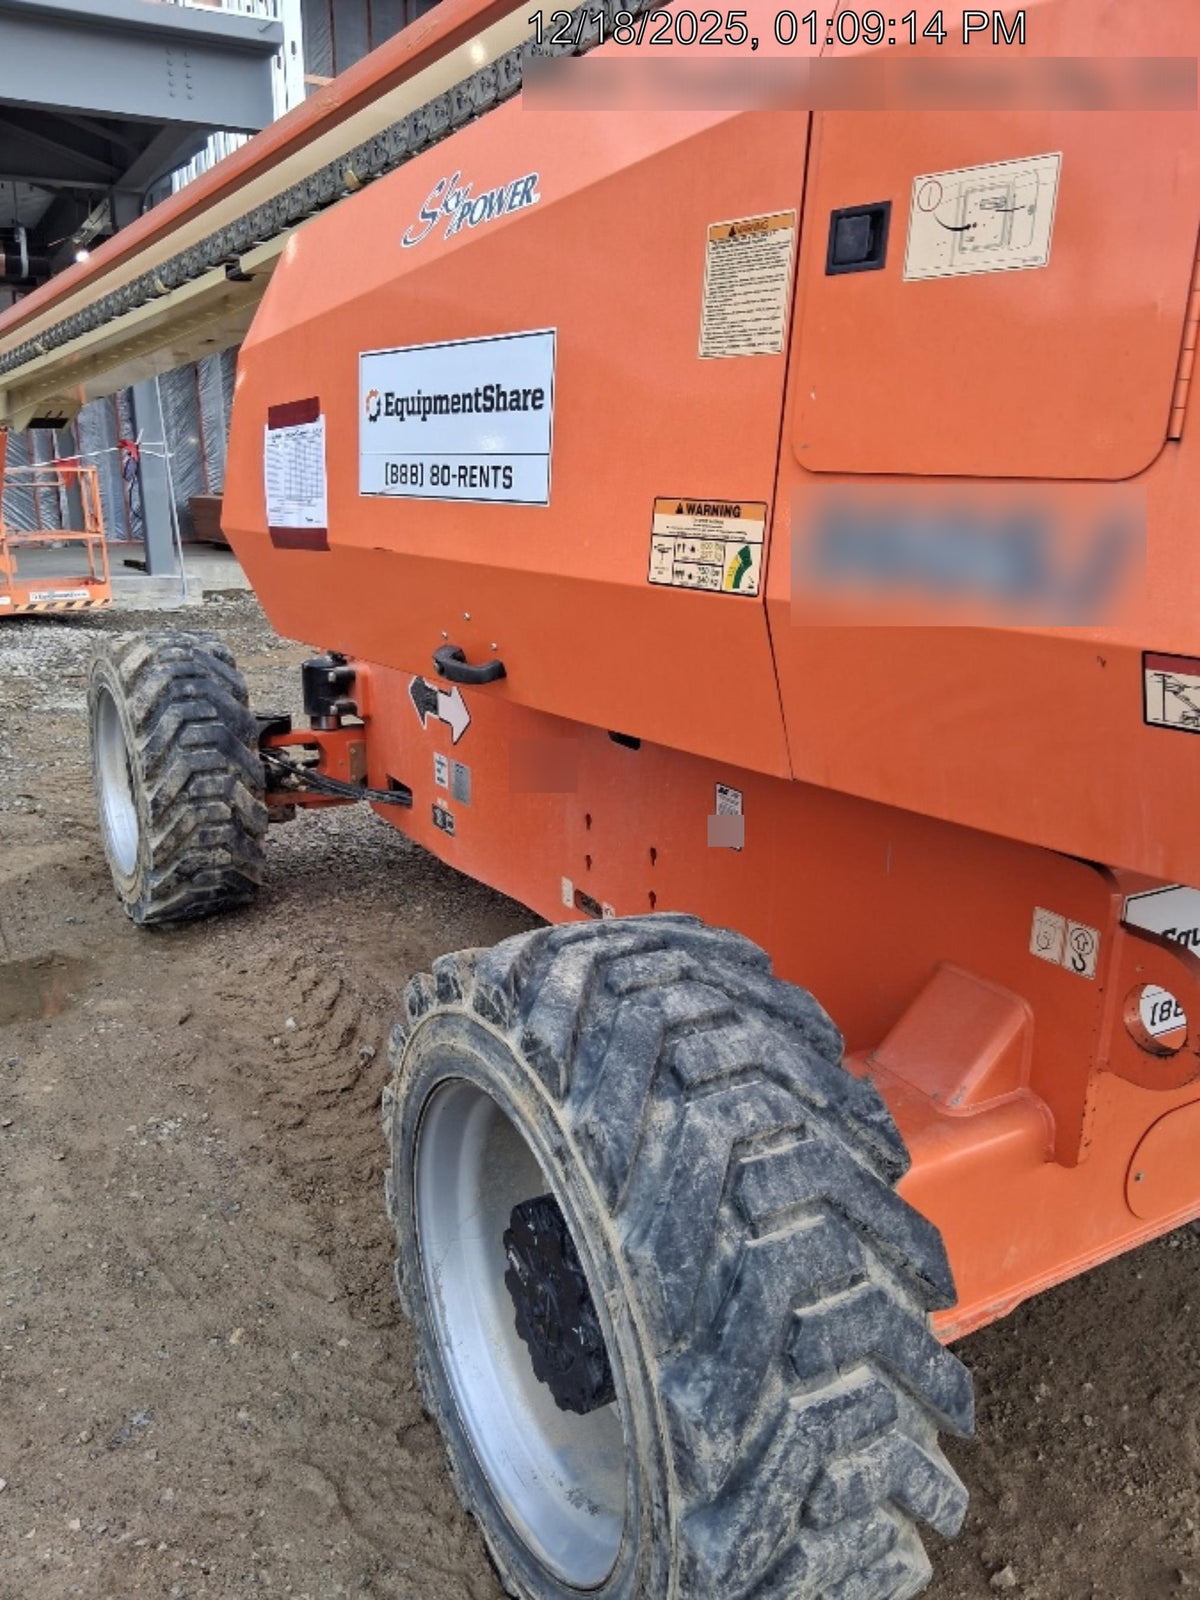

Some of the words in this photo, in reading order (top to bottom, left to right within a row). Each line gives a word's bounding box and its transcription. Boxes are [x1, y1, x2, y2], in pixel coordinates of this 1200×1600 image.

[455, 173, 537, 232] POWER
[383, 383, 545, 422] EquipmentShare
[429, 464, 513, 489] 80-RENTS
[685, 502, 742, 518] WARNING
